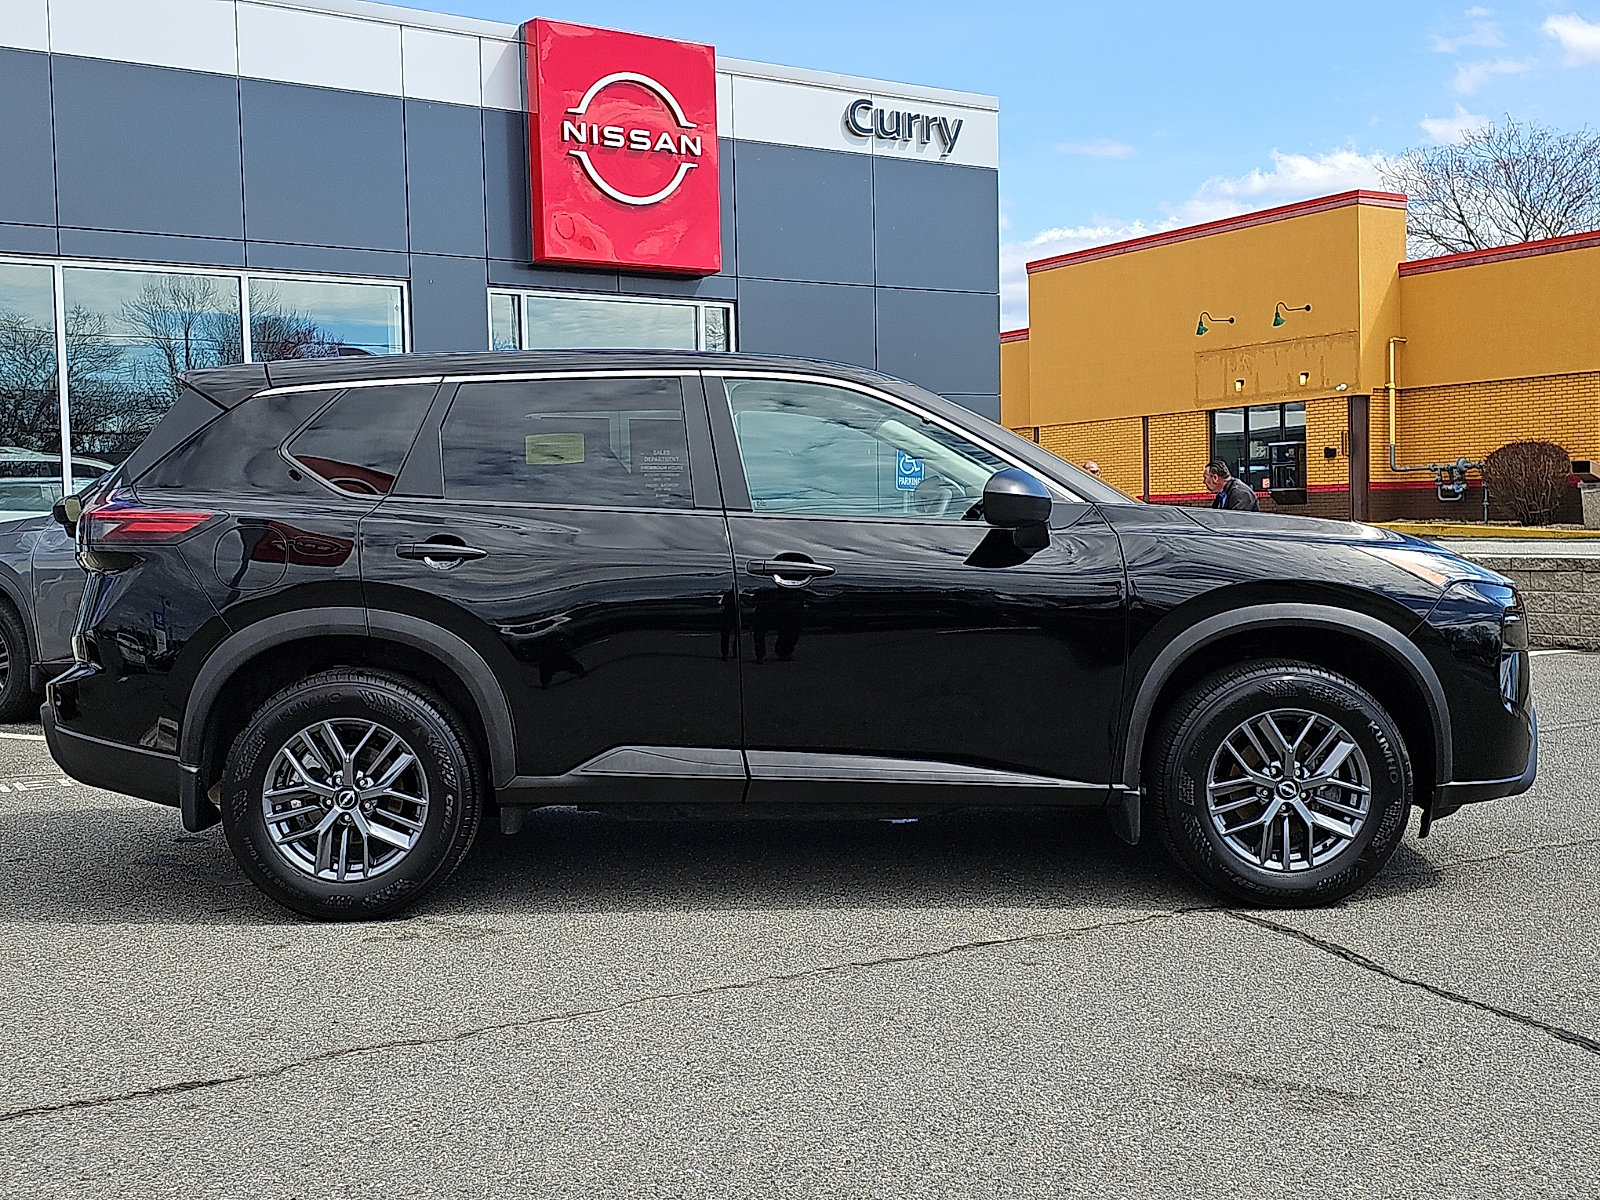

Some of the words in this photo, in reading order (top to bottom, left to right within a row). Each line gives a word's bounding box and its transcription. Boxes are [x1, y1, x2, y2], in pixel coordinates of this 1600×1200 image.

[562, 120, 702, 156] NISSAN
[845, 98, 964, 156] Curry
[1367, 720, 1399, 784] KUMHO
